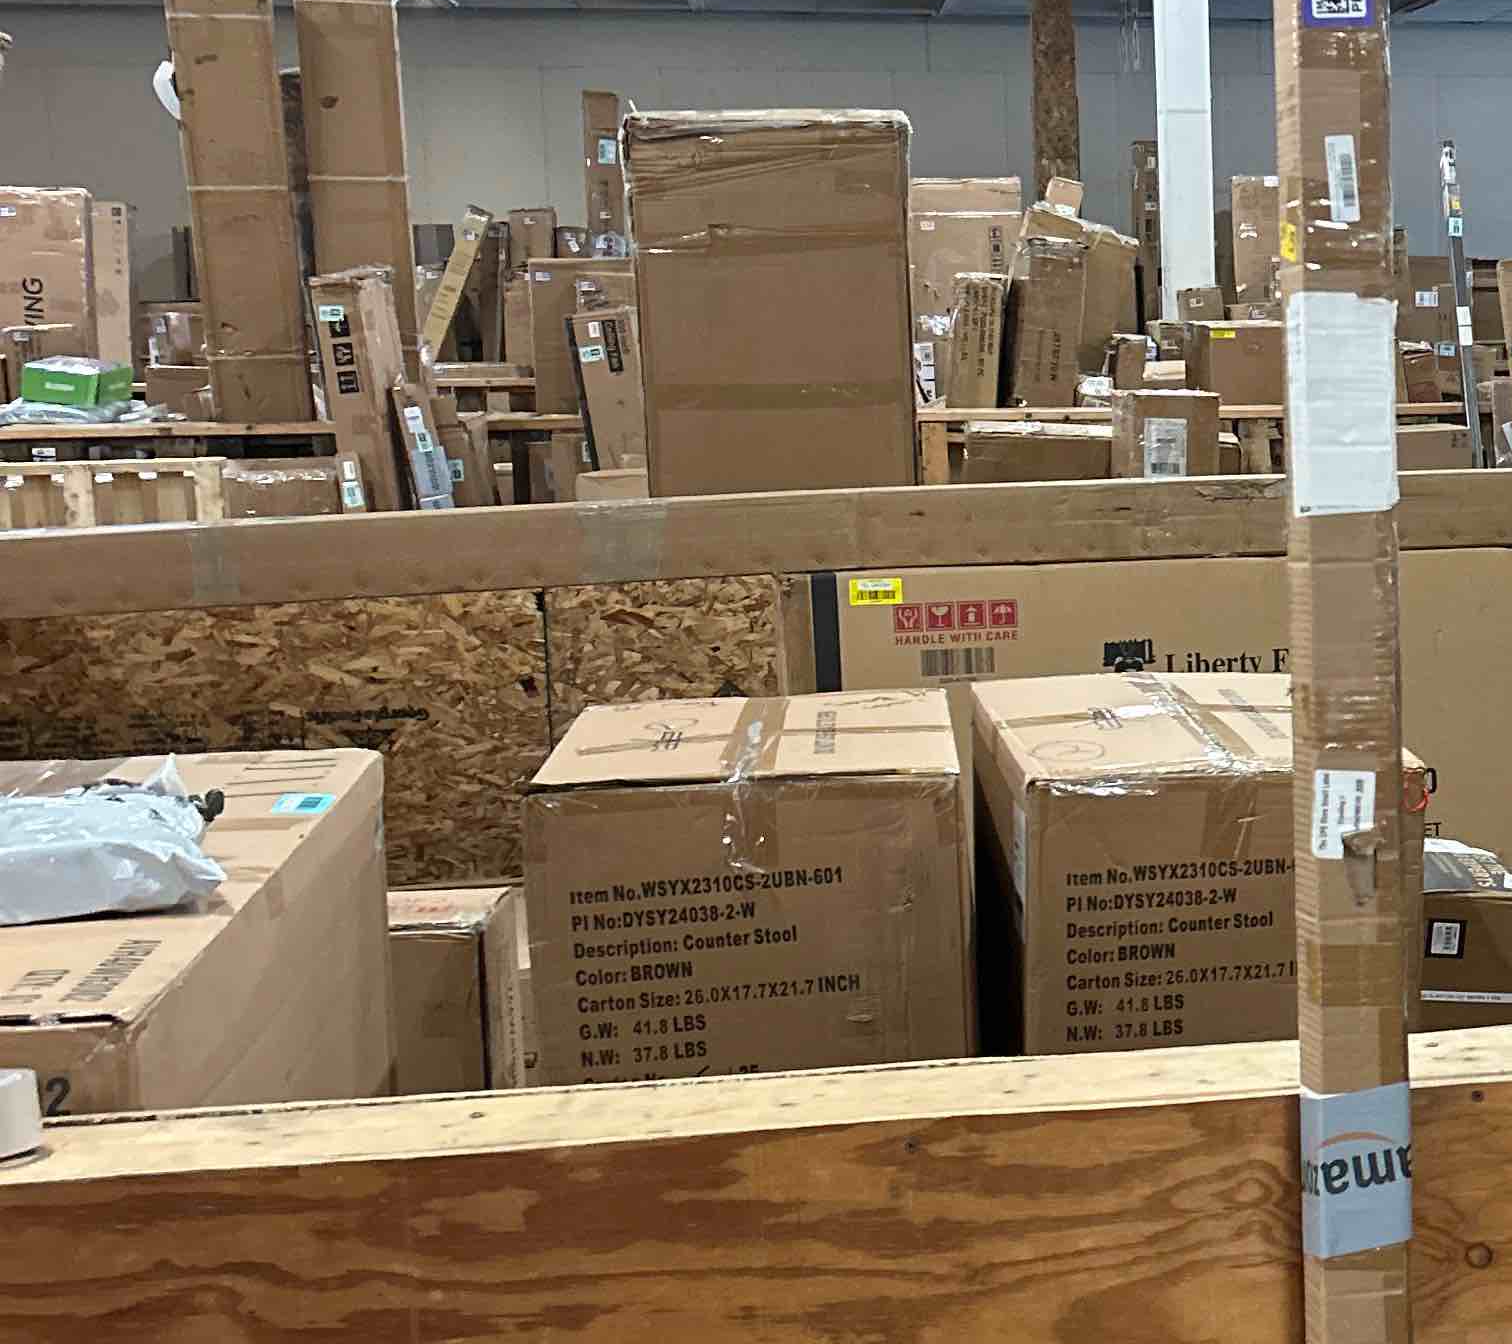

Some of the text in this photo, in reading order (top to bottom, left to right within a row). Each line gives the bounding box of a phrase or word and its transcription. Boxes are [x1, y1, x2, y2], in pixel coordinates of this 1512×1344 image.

[895, 630, 1018, 645] HANDLE WITH CARE
[1165, 651, 1263, 672] Liberty
[1066, 872, 1102, 886] Item
[570, 890, 609, 905] Item
[1066, 911, 1273, 940] Description: Counter Stool
[574, 925, 797, 959] Description: Counter Stool
[1066, 943, 1175, 965] Color: BROWN
[575, 961, 693, 986] Color: BROWN
[1066, 973, 1120, 991] Carton
[1124, 971, 1162, 988] Size:
[1166, 963, 1284, 985] 26.0X17.7X21.7
[577, 974, 861, 1014] Carton Size: 26.0X17.7X21.7 INCH
[1066, 994, 1184, 1017] G.W: 41.8 LBS
[579, 1014, 707, 1041] G.W: 41.8 LBS
[1066, 1019, 1184, 1042] N.W: 37.8 LBS
[581, 1041, 707, 1068] N.W: 37.8 LBS
[46, 1077, 71, 1116] 2
